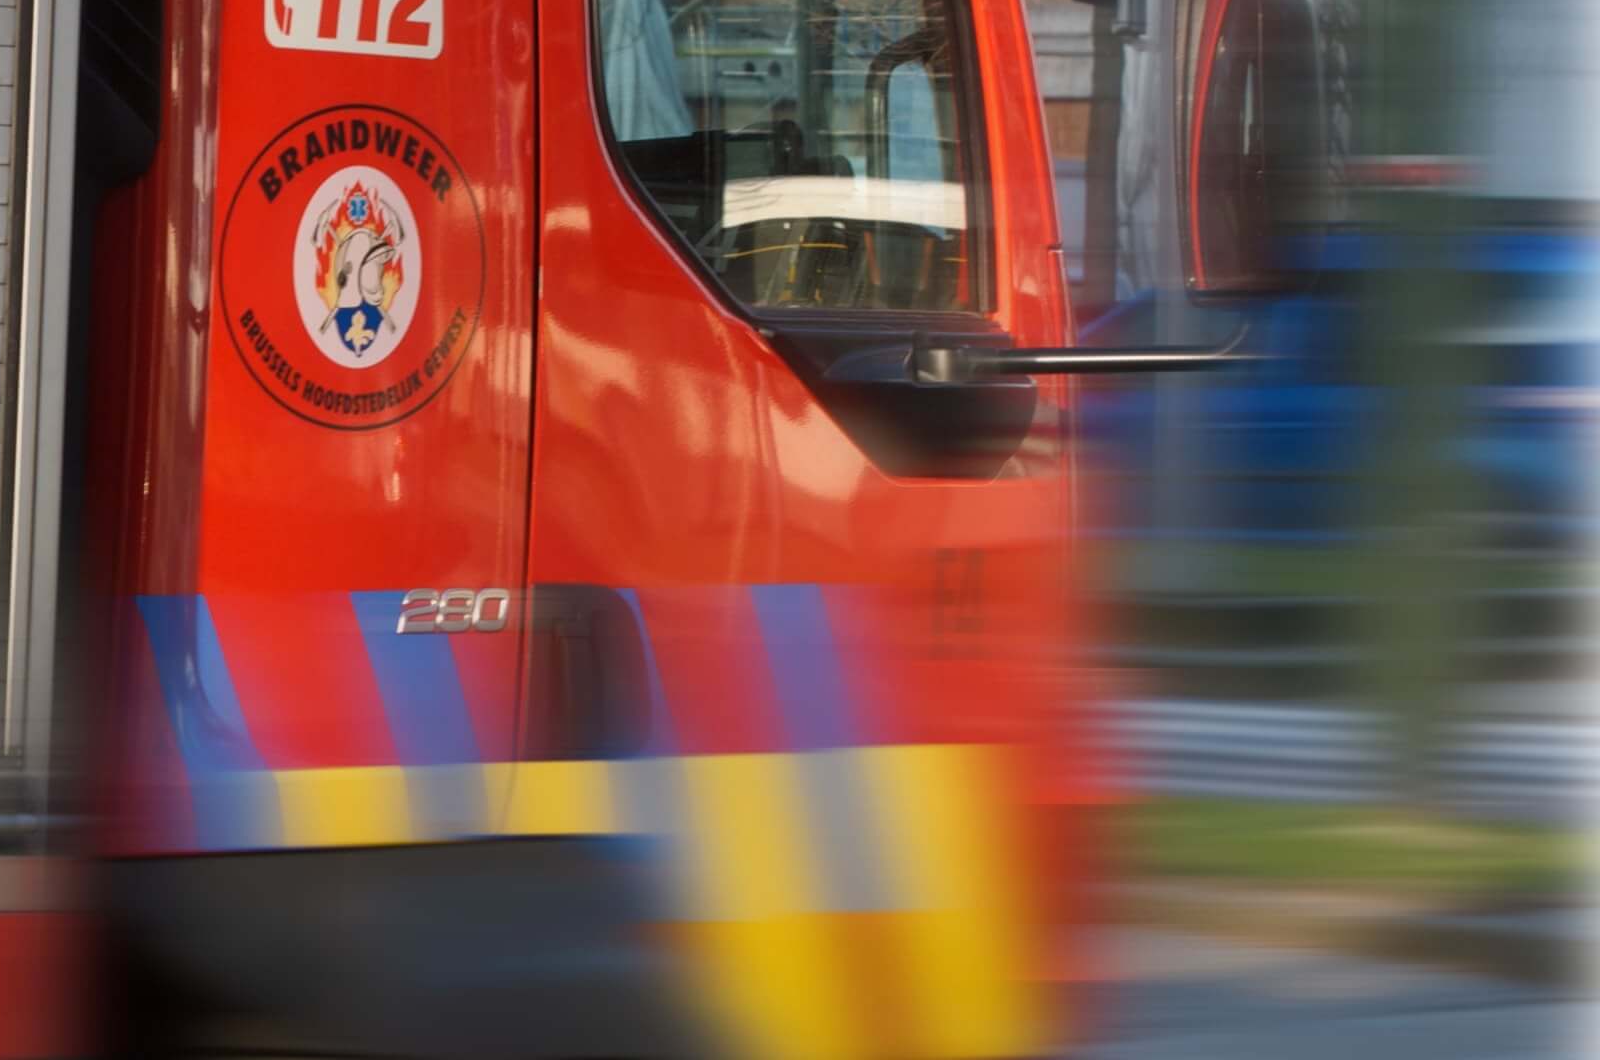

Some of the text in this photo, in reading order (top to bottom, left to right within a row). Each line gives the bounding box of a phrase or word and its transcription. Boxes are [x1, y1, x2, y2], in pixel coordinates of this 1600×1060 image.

[257, 118, 453, 204] BRANDWEER
[239, 306, 468, 416] BRUSSELS HOOFDSTEDELIJK GEWEST
[395, 587, 511, 635] 280
